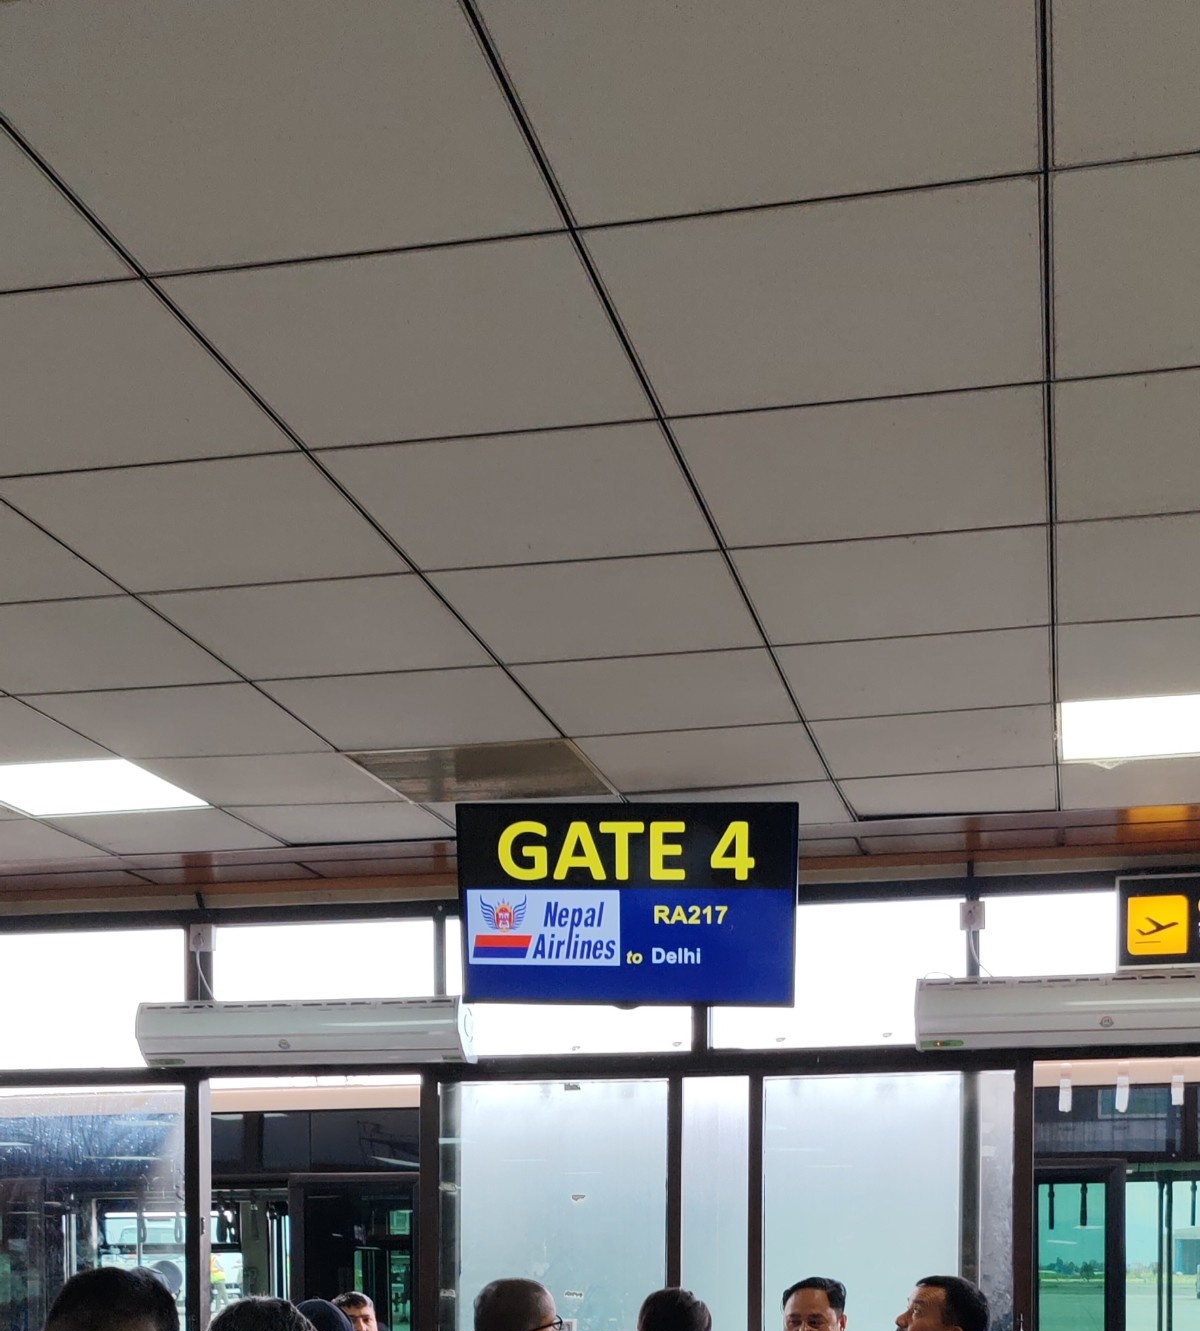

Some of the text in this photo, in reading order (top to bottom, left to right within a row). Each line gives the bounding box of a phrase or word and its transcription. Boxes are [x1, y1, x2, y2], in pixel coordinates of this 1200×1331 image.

[497, 820, 756, 881] GATE 4
[543, 900, 605, 937] Nepal
[653, 904, 728, 926] RA217
[532, 931, 617, 961] Airlines
[626, 946, 701, 965] to Delhi
